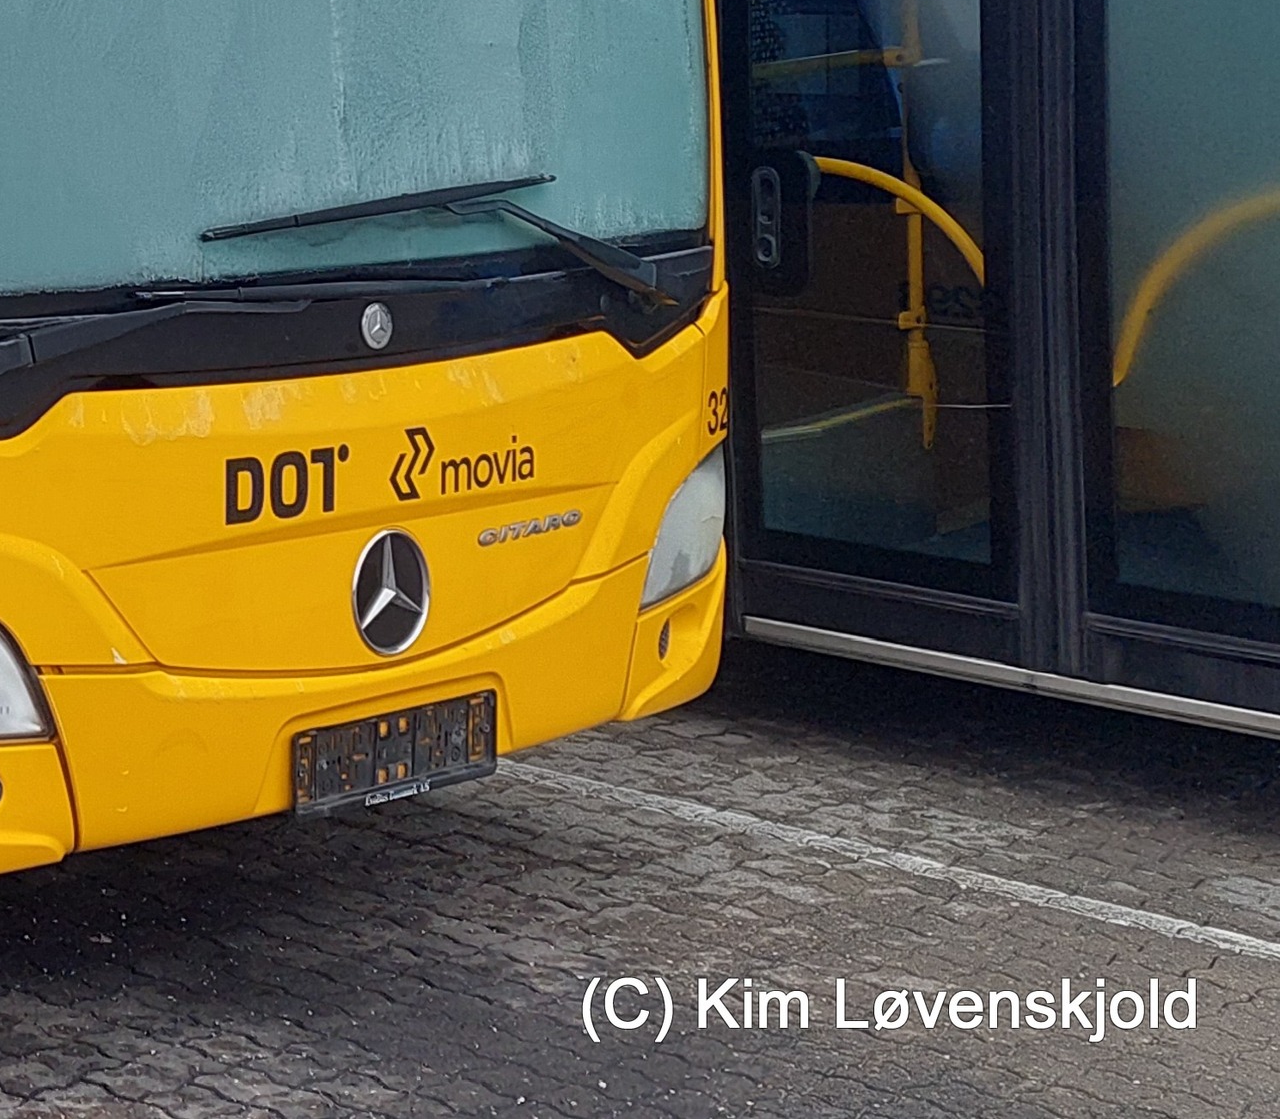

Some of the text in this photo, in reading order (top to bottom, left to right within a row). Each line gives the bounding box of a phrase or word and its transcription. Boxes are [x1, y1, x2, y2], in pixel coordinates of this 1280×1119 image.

[225, 444, 350, 526] DOT
[441, 435, 535, 495] movia
[478, 509, 583, 546] CITARO
